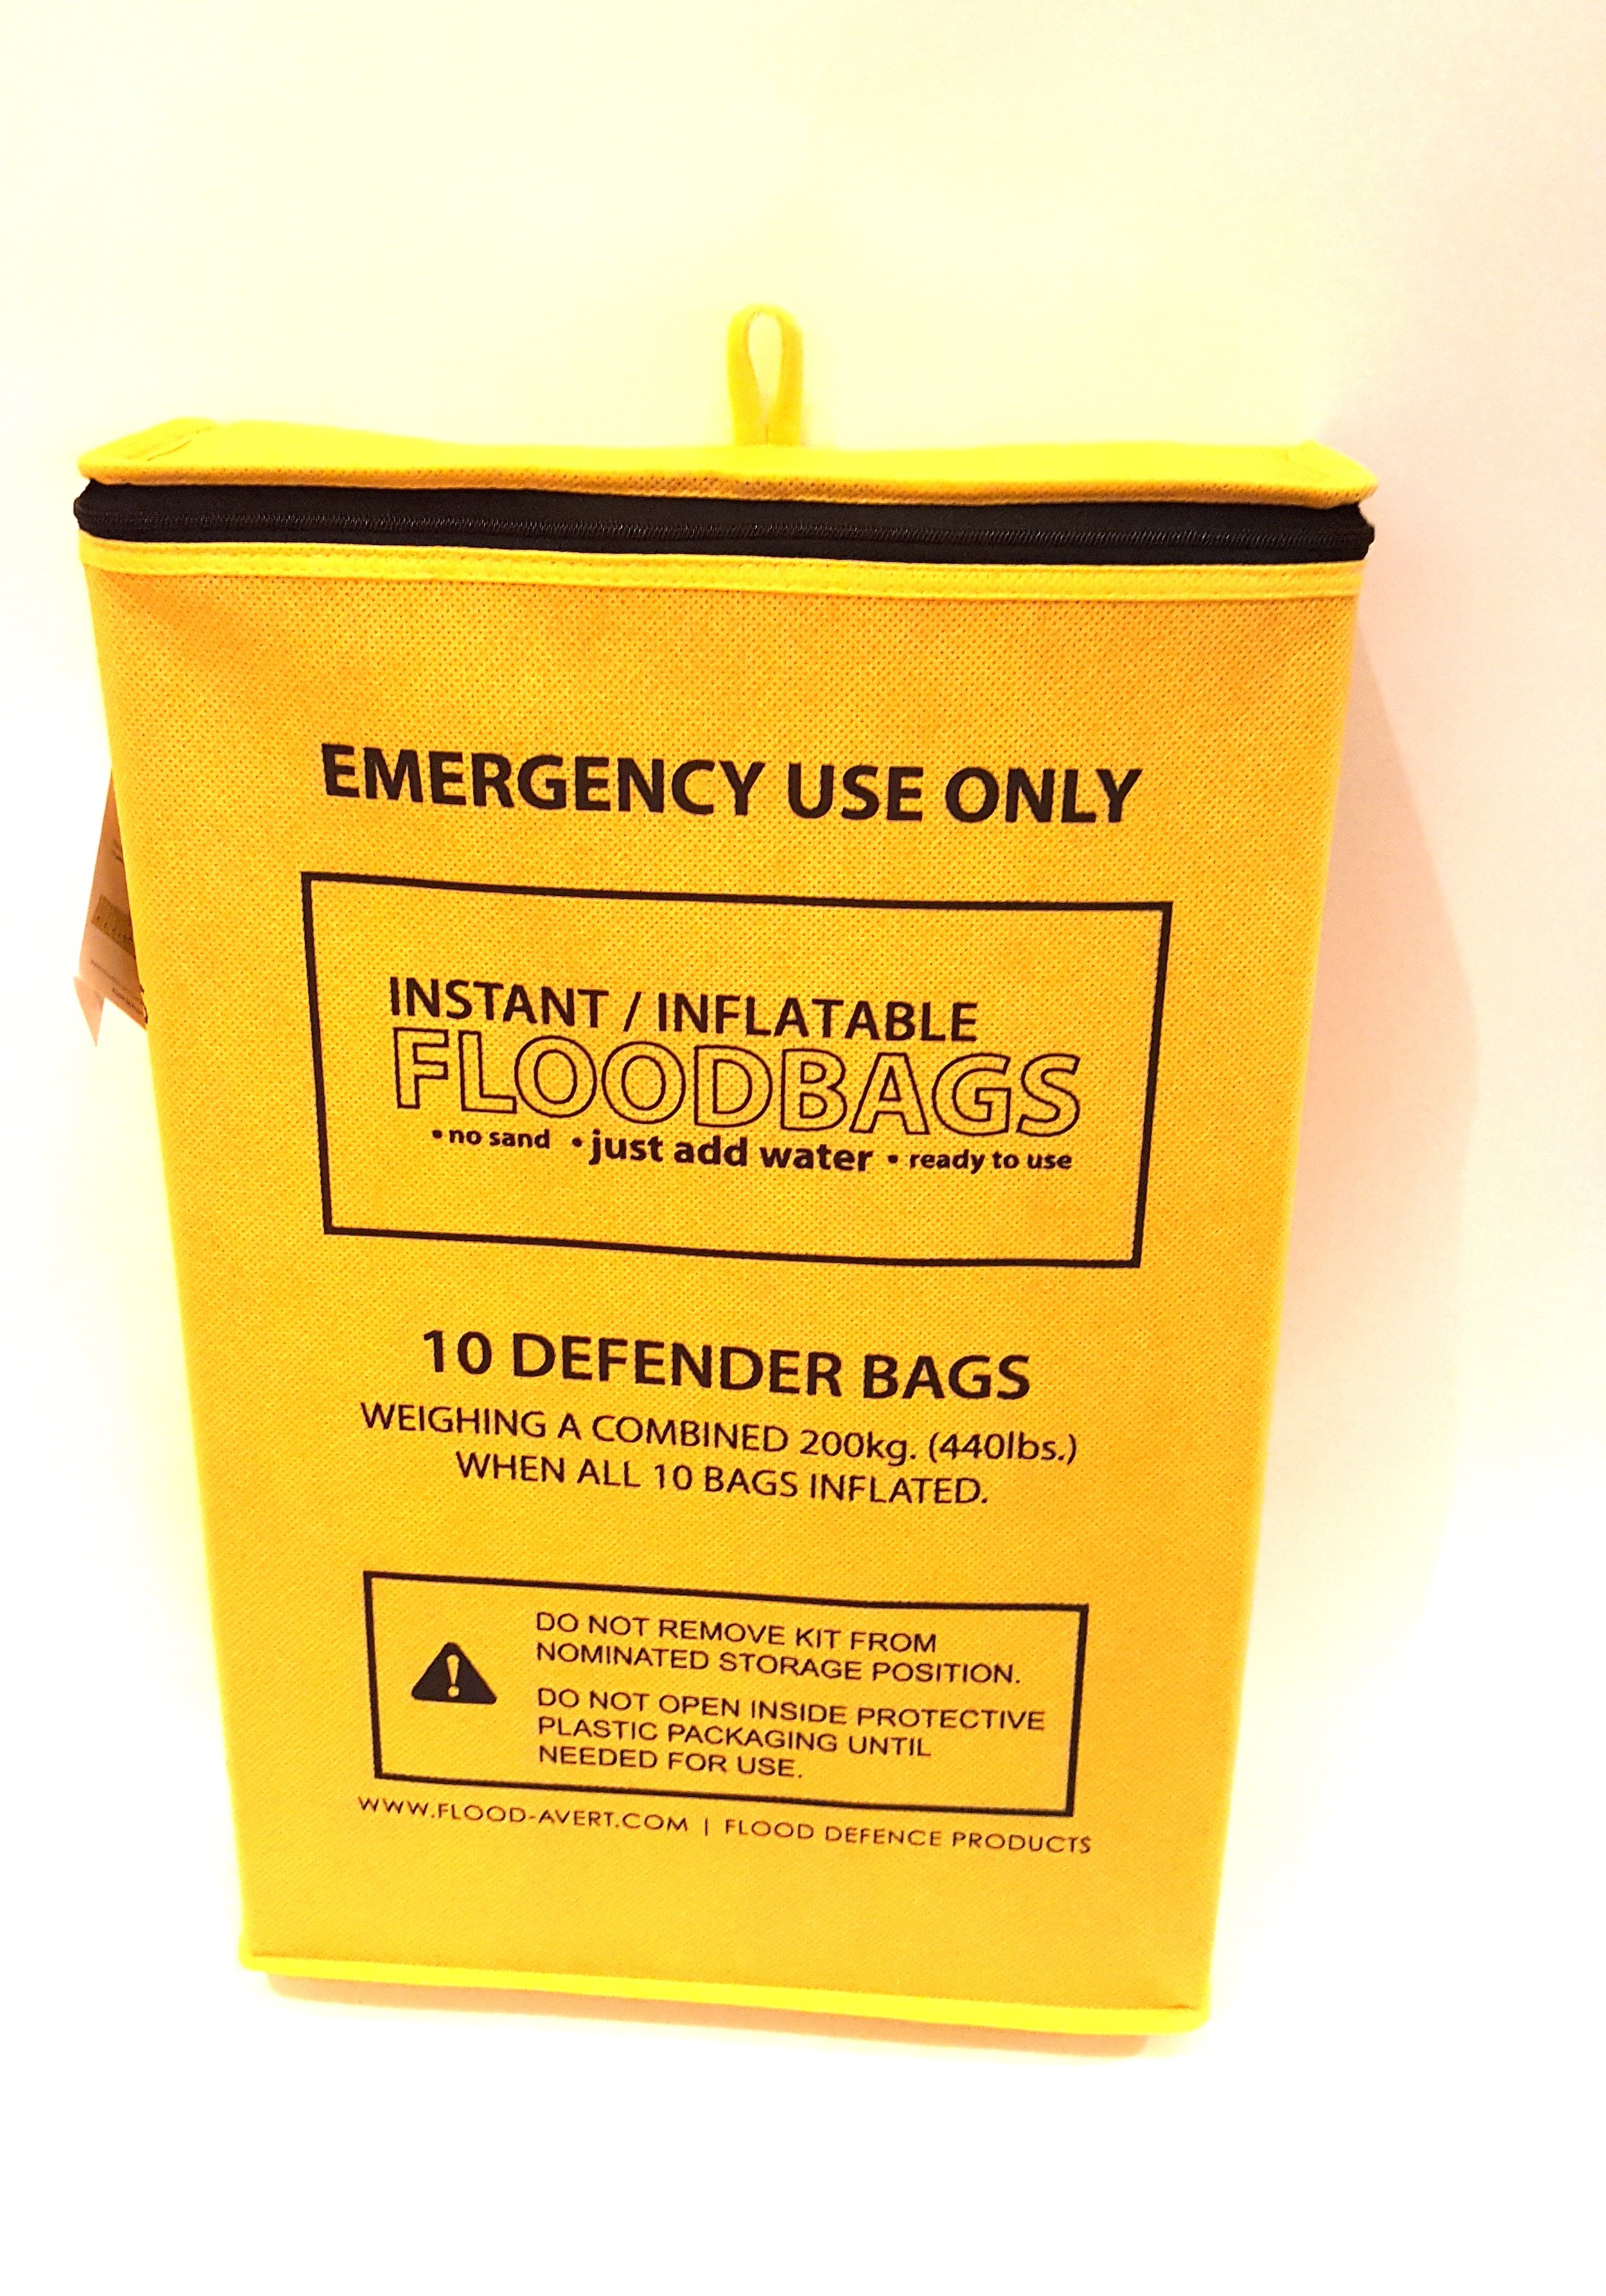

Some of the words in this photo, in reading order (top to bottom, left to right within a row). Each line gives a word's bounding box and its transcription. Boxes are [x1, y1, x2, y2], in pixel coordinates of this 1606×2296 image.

[321, 743, 766, 817] EMERGENCY
[788, 762, 924, 822] USE
[944, 767, 1143, 824] ONLY
[389, 977, 609, 1028] INSTANT
[623, 992, 642, 1032] /
[658, 992, 978, 1043] INFLATABLE
[393, 1027, 1081, 1137] FLOODBAGS
[449, 1130, 482, 1145] no
[490, 1128, 550, 1149] sand
[588, 1128, 663, 1166] just
[674, 1135, 748, 1167] add
[759, 1144, 874, 1172] water
[910, 1149, 985, 1175] ready
[992, 1151, 1019, 1169] to
[1027, 1153, 1072, 1170] use
[423, 1330, 492, 1375] 10
[513, 1333, 842, 1397] DEFENDER
[863, 1354, 1030, 1400] BAGS
[360, 1402, 546, 1438] WEIGHING
[558, 1413, 581, 1440] A
[592, 1415, 788, 1452] COMBINED
[800, 1429, 915, 1466] 200kg.
[929, 1431, 1077, 1465] (440lbs.)
[455, 1451, 565, 1483] WHEN
[577, 1458, 640, 1488] ALL
[655, 1464, 693, 1490] 10
[705, 1466, 797, 1497] BAGS
[811, 1473, 987, 1504] INFLATED.
[536, 1612, 579, 1632] DO
[588, 1615, 649, 1636] NOT
[659, 1619, 784, 1645] REMOVE
[796, 1628, 841, 1649] KIT
[851, 1632, 936, 1653] FROM
[537, 1642, 709, 1669] NOMINATED
[719, 1651, 861, 1680] STORAGE
[872, 1662, 1020, 1684] POSITION.
[538, 1687, 579, 1708] DO
[590, 1691, 649, 1711] NOT
[659, 1695, 739, 1717] OPEN
[752, 1700, 847, 1724] INSIDE
[858, 1707, 1044, 1730] PROTECTIVE
[538, 1716, 657, 1741] PLASTIC
[668, 1723, 837, 1752] PACKAGING
[849, 1736, 931, 1756] UNTIL
[540, 1745, 657, 1768] NEEDED
[669, 1752, 727, 1772] FOR
[737, 1756, 801, 1777] USE.
[358, 1797, 687, 1831] WWW.FLOOD-AVERT.COM
[725, 1819, 813, 1838] FLOOD
[825, 1826, 940, 1846] DEFENCE
[953, 1832, 1090, 1853] PRODUCTS
